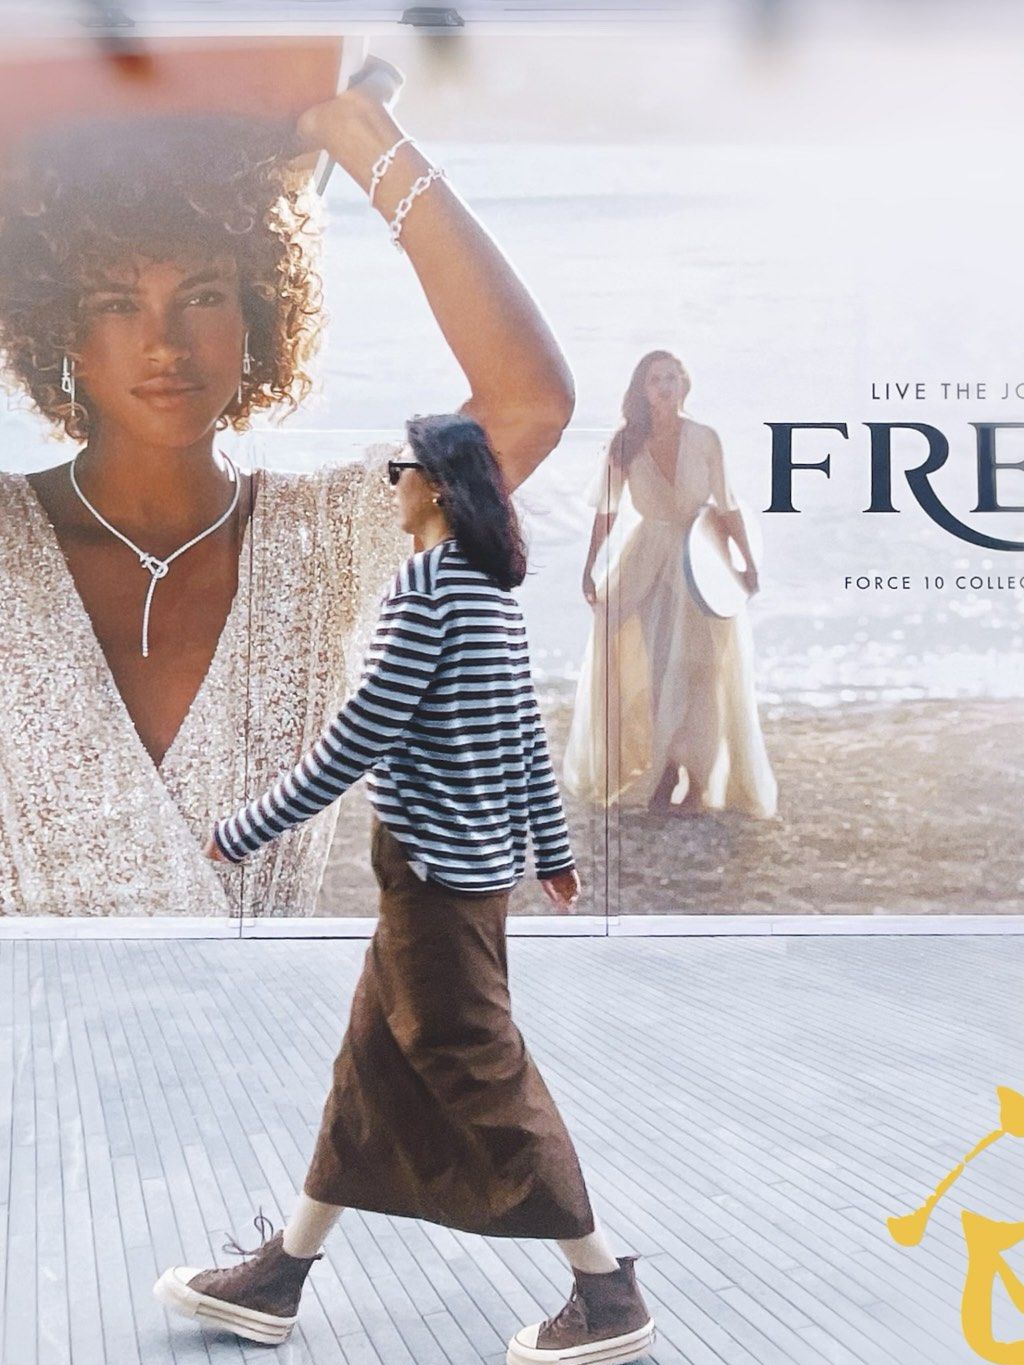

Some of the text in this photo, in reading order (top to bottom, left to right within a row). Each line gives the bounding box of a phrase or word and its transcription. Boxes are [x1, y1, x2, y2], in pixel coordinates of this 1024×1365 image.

[872, 383, 926, 400] LIVE
[941, 383, 987, 400] THE
[762, 422, 1024, 551] FRE
[844, 576, 912, 590] FORCE
[924, 576, 945, 590] 10
